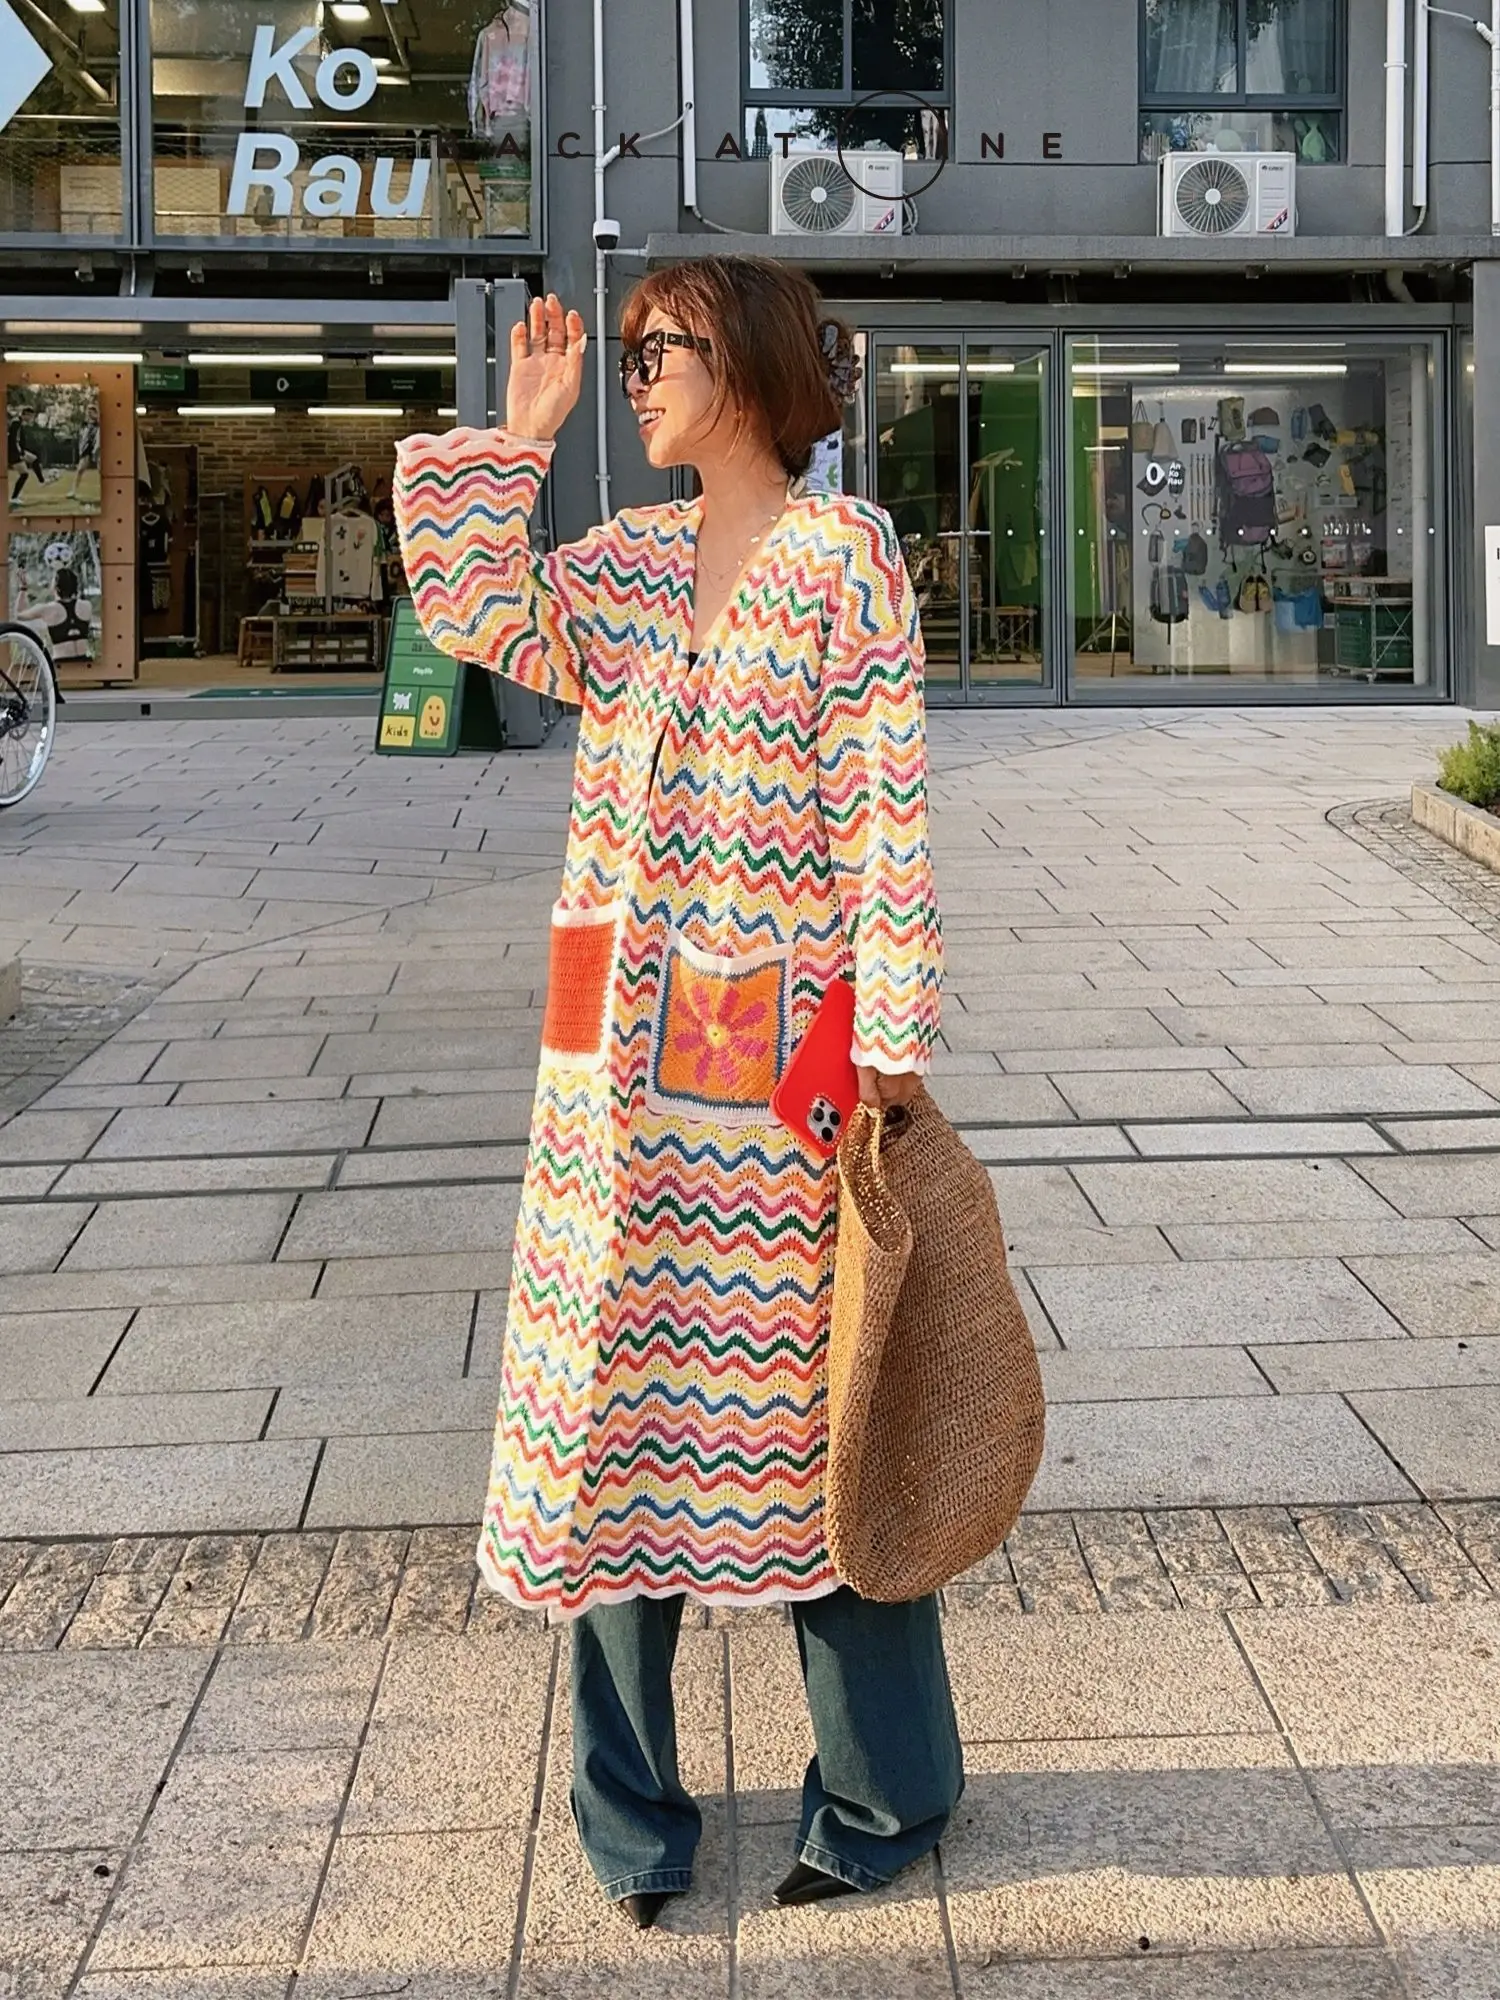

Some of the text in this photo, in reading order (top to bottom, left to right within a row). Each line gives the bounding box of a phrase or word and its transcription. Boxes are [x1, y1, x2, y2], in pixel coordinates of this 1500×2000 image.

[243, 25, 378, 111] Ko
[226, 132, 431, 218] Rau
[1170, 461, 1182, 470] An
[1168, 470, 1179, 478] Ko
[1168, 477, 1183, 485] Rau
